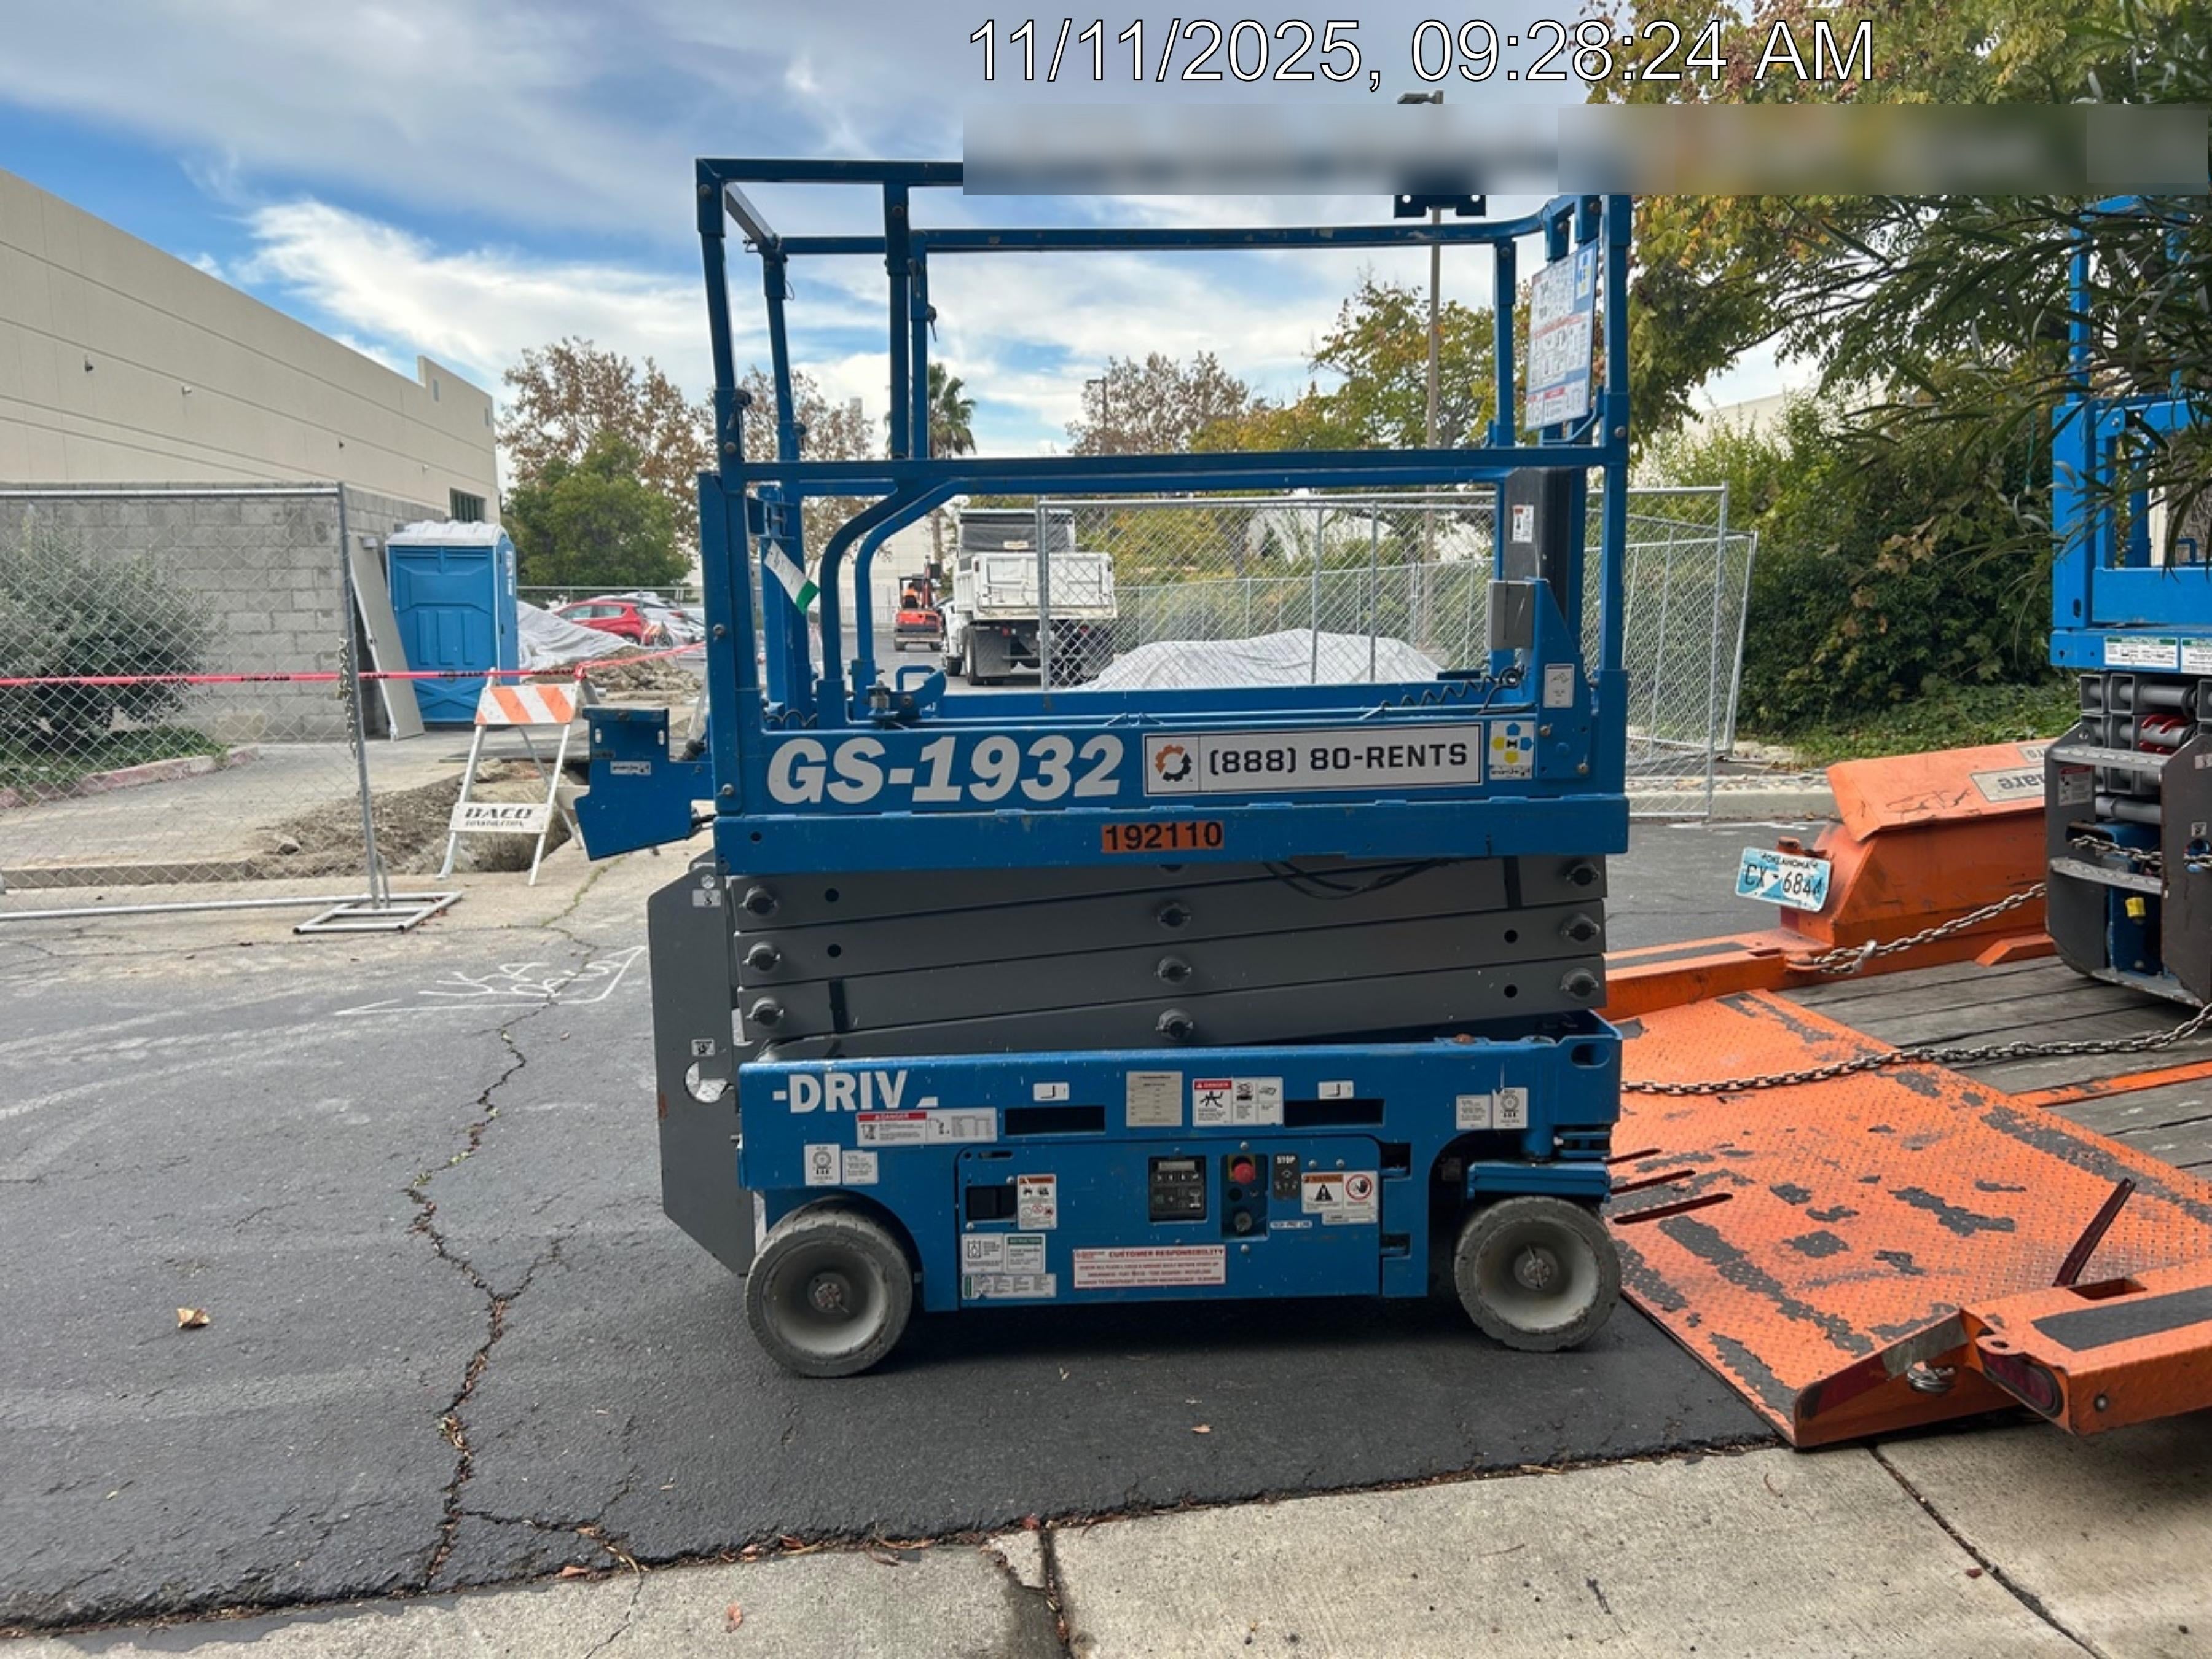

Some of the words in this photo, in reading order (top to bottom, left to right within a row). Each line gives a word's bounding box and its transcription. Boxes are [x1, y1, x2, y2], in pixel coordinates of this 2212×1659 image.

[767, 734, 1124, 804] GS-1932
[1210, 747, 1296, 775] (888)
[1310, 743, 1467, 771] 80-RENTS
[1106, 822, 1223, 850] 192110
[1276, 1155, 1296, 1164] STOP
